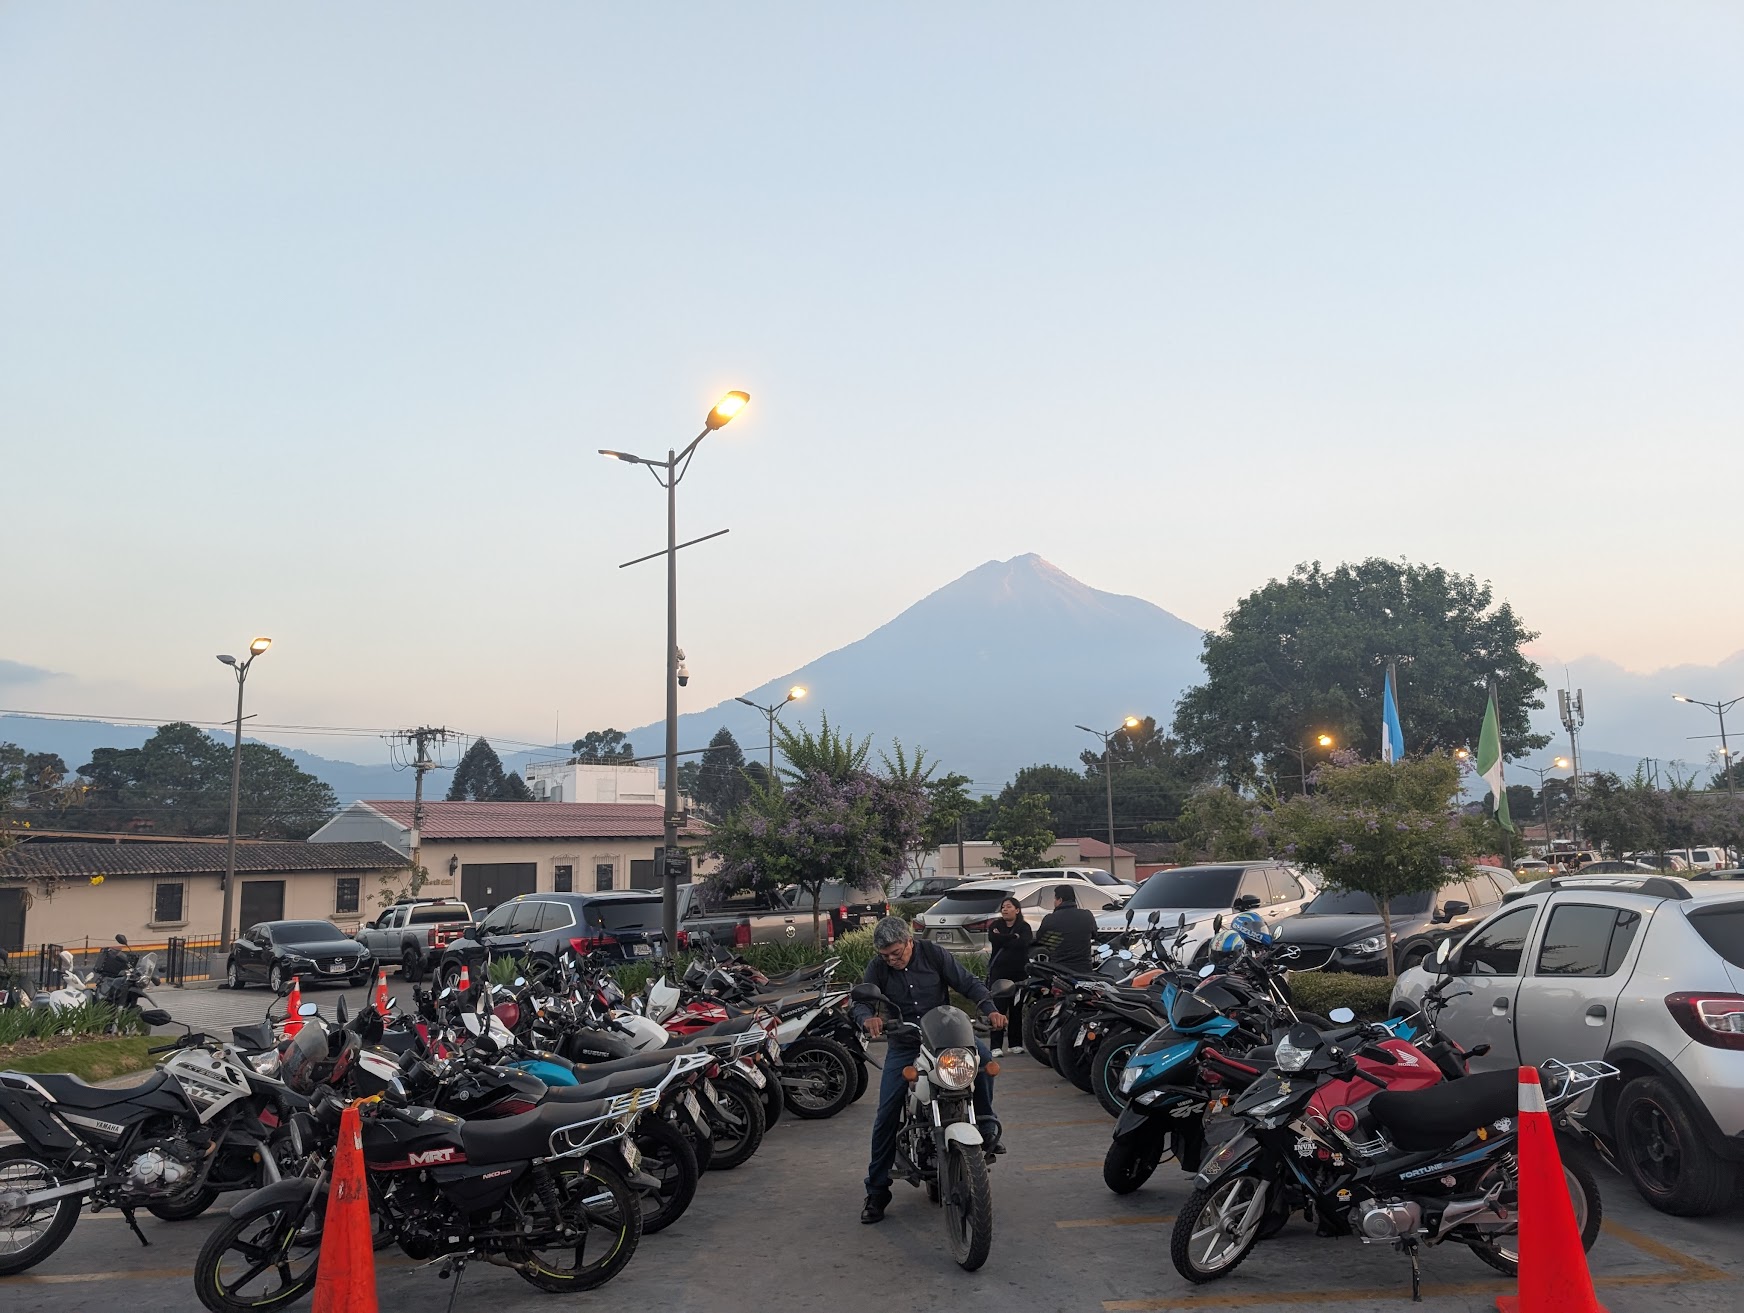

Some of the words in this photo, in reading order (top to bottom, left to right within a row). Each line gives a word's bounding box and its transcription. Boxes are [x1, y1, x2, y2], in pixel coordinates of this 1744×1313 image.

[781, 1005, 808, 1018] HONDA
[95, 1120, 119, 1132] YAMAHA
[409, 1148, 455, 1166] MRT
[1399, 1162, 1444, 1180] FORTUNE
